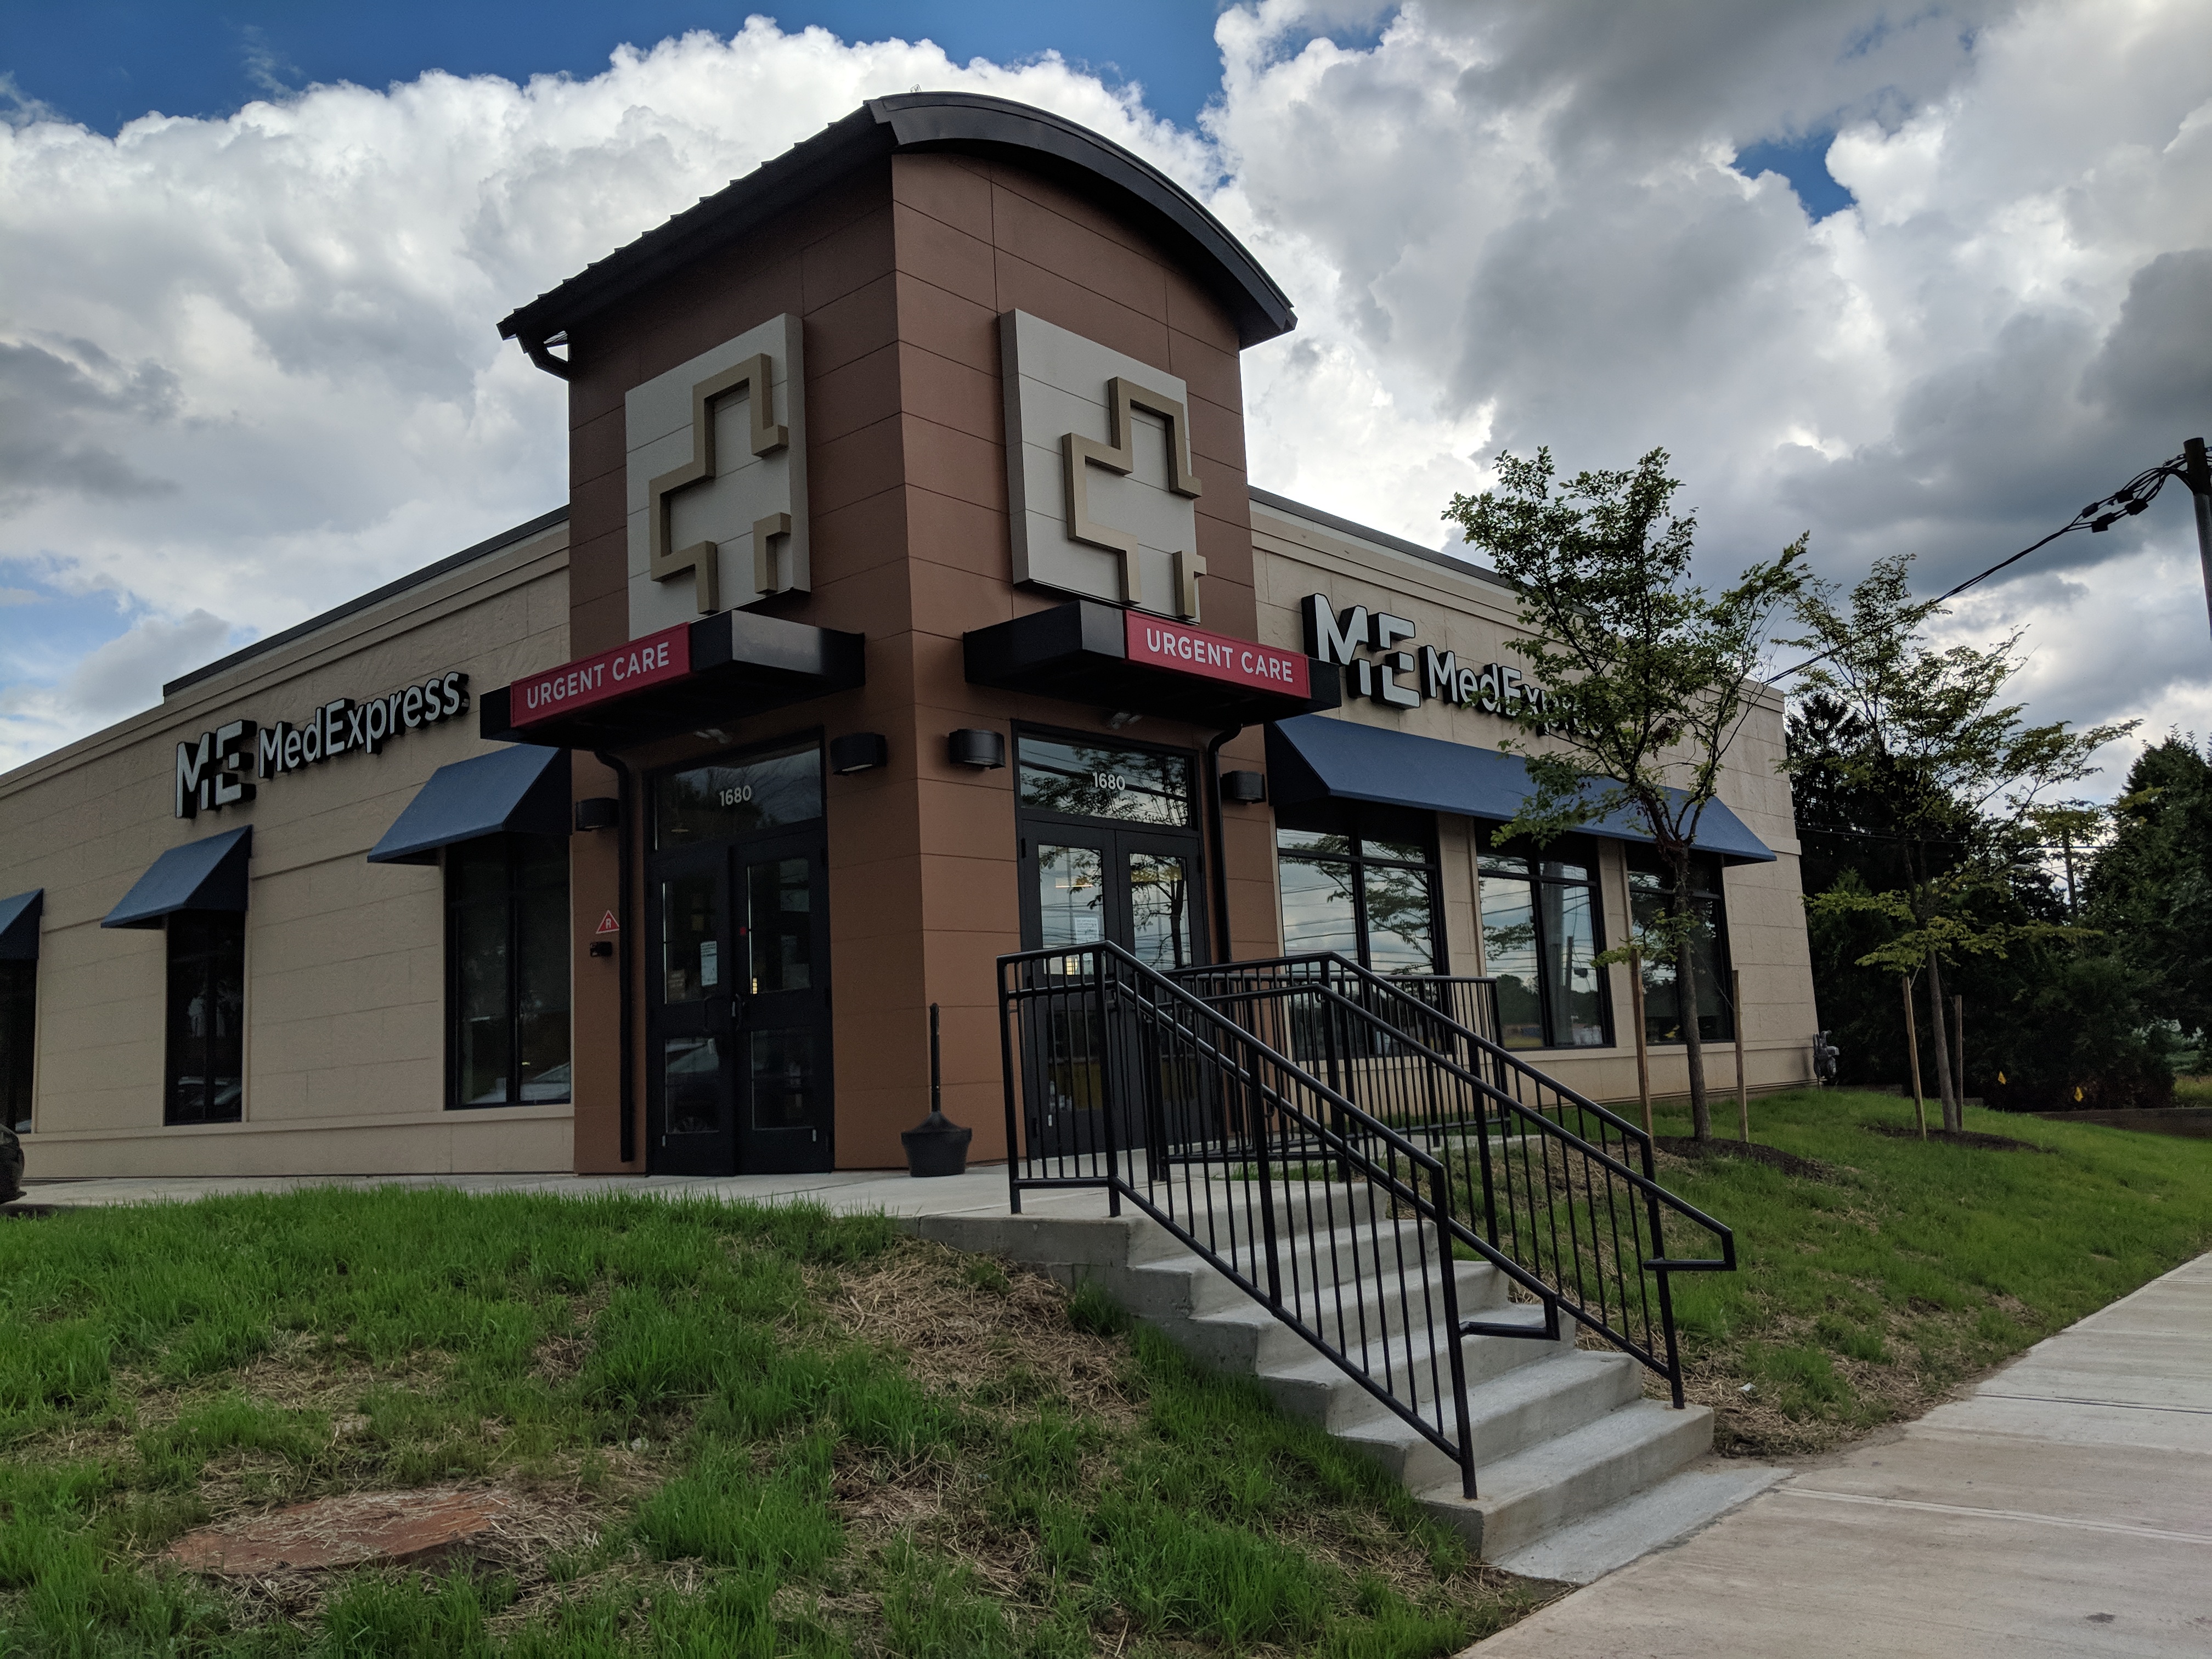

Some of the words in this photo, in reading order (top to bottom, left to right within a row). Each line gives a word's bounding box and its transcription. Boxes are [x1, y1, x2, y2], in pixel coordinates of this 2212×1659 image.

[526, 663, 605, 709] URGENT
[612, 642, 670, 681] CARE
[1147, 628, 1233, 669] URGENT
[1241, 651, 1294, 683] CARE
[1315, 593, 1421, 708] ME
[176, 720, 245, 819] ME
[259, 671, 461, 778] MedExpress
[719, 785, 752, 807] 1680
[1092, 771, 1126, 791] 1680
